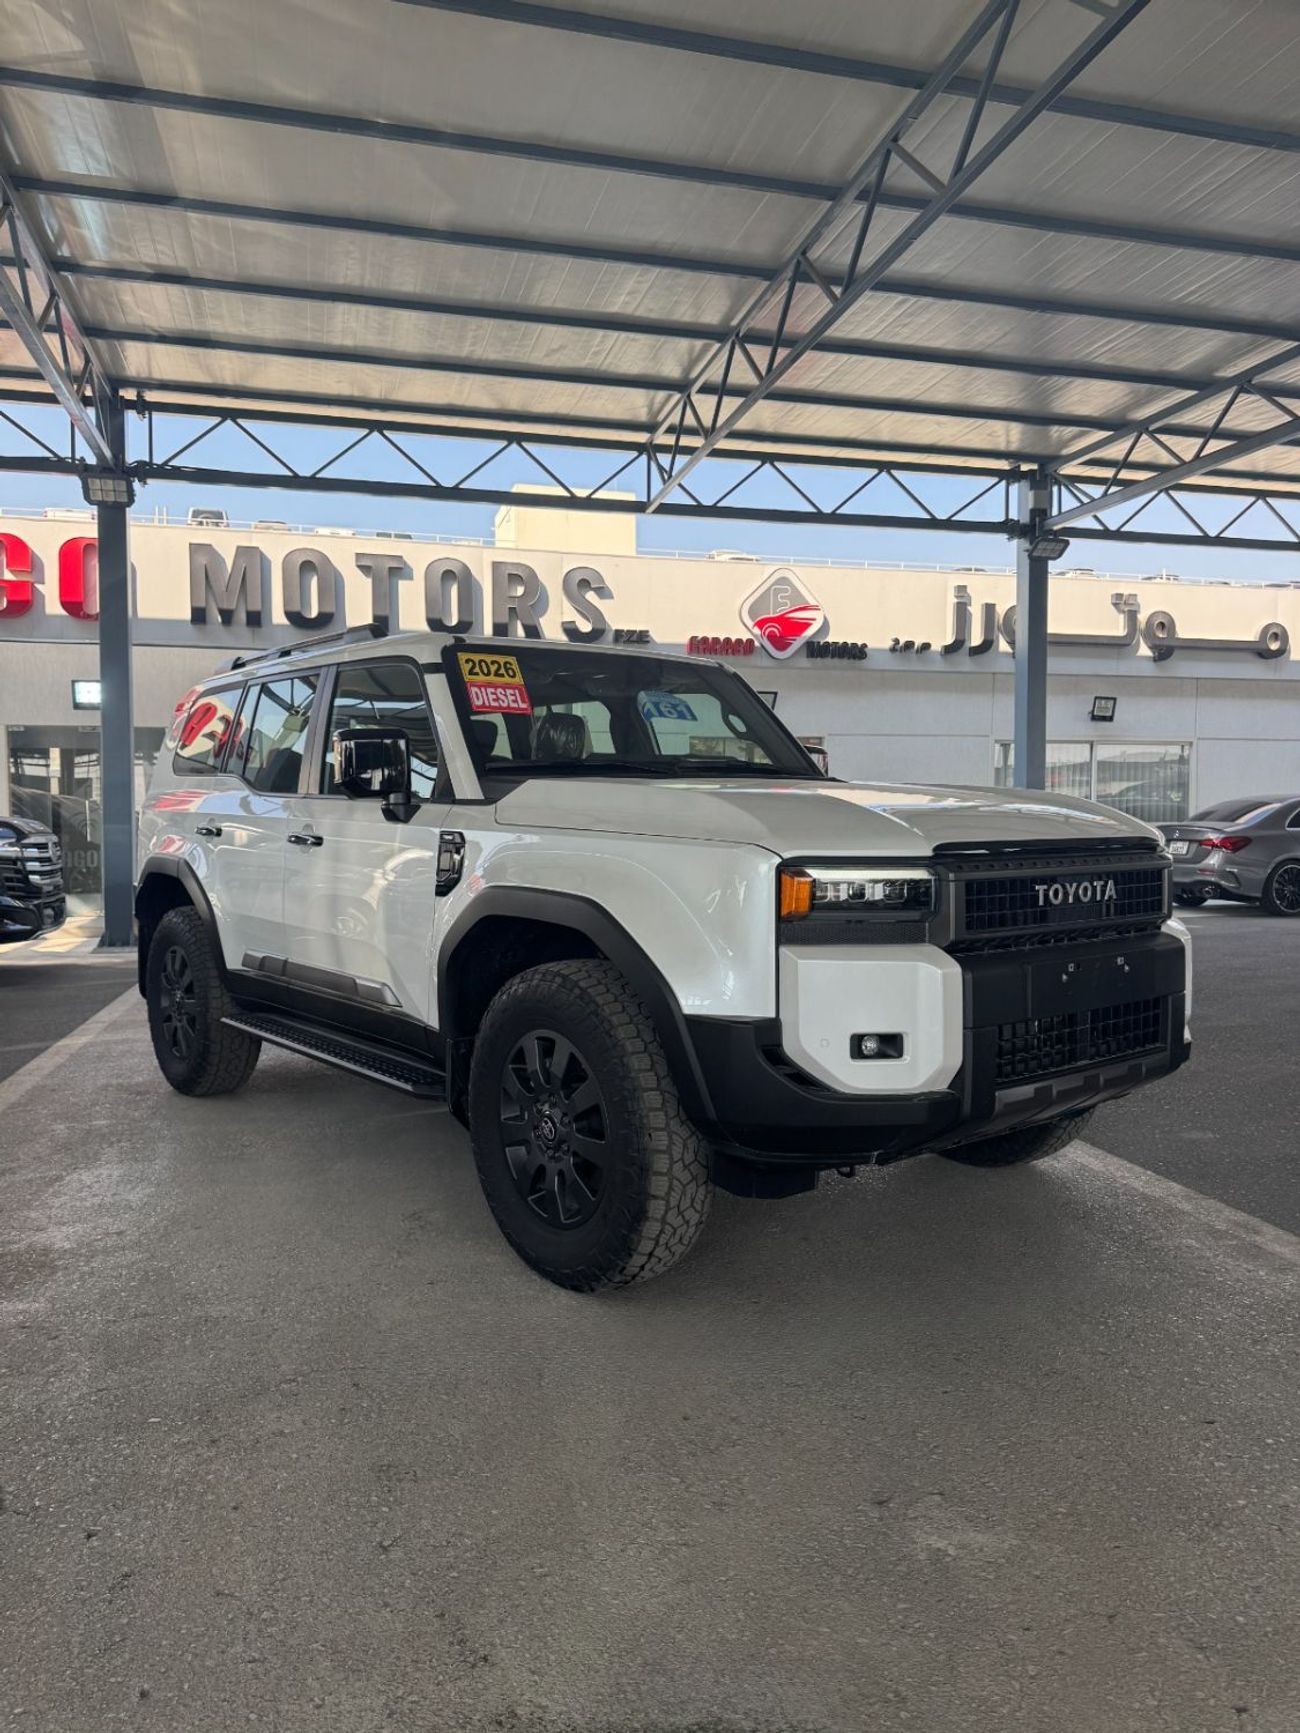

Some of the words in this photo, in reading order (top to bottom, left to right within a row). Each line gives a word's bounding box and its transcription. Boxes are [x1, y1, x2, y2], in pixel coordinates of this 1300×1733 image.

[188, 543, 607, 644] MOTORS
[613, 629, 650, 644] FZE
[465, 658, 517, 678] 2026
[470, 686, 528, 708] DIESEL
[1035, 880, 1117, 906] TOYOTA
